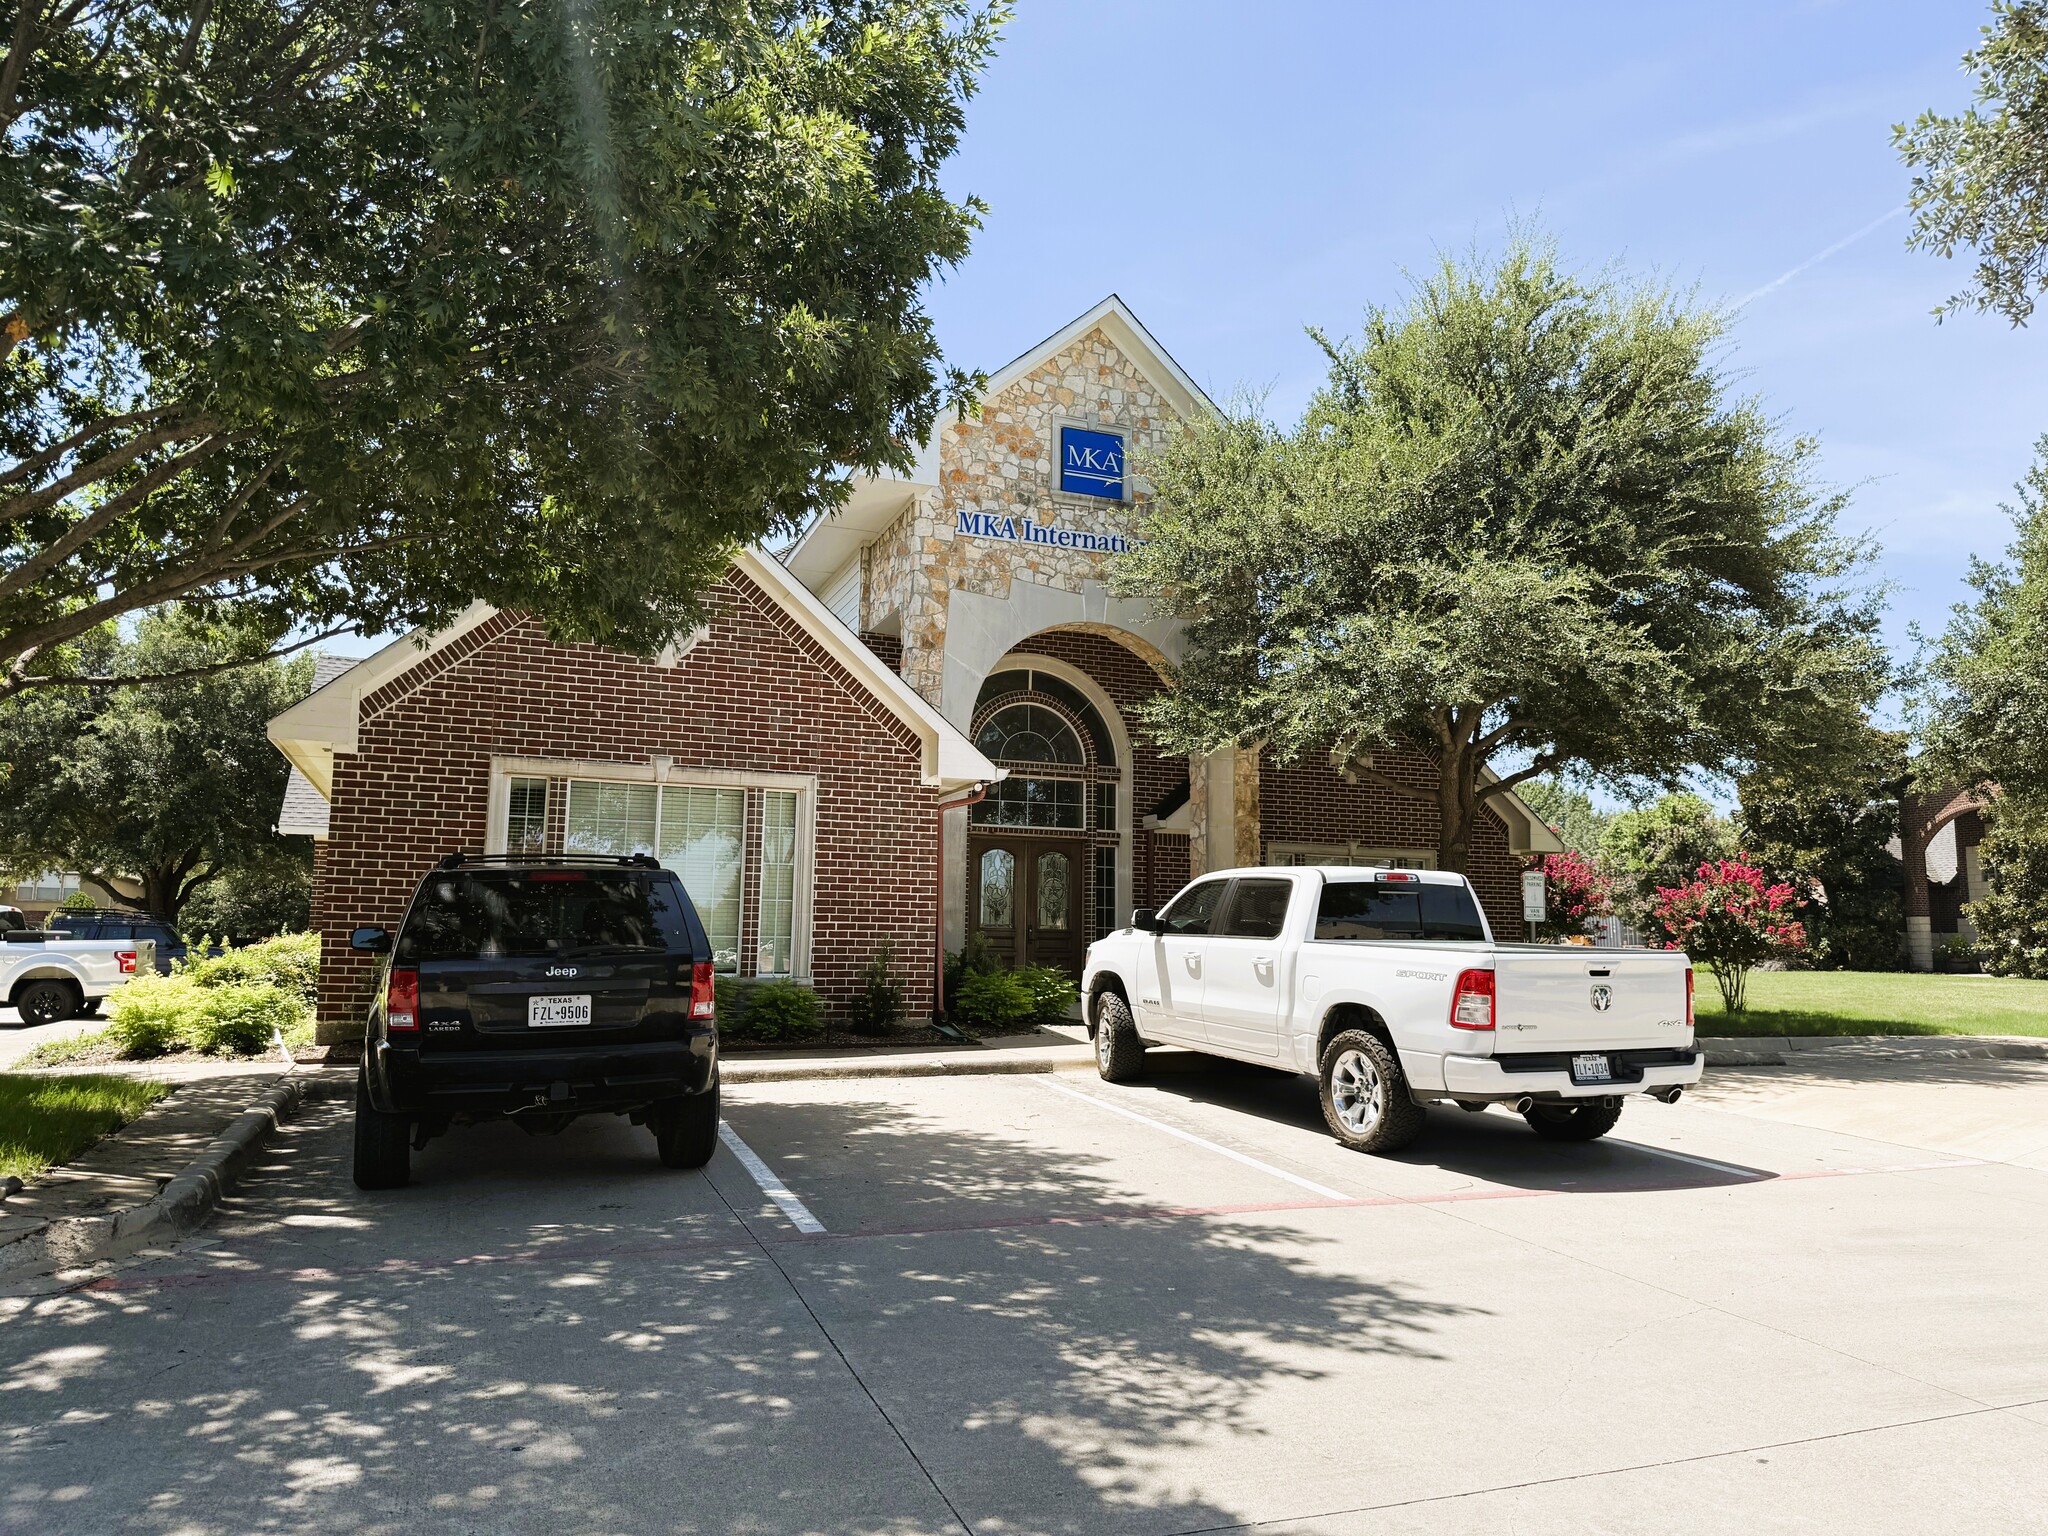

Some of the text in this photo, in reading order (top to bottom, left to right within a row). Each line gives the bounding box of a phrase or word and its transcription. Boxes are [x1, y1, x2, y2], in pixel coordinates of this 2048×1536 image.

[1067, 444, 1120, 473] MKA
[957, 511, 1150, 553] MKA Internati
[545, 966, 578, 978] Jeep
[1395, 969, 1448, 982] SPORT
[532, 1005, 589, 1021] FZL 9506
